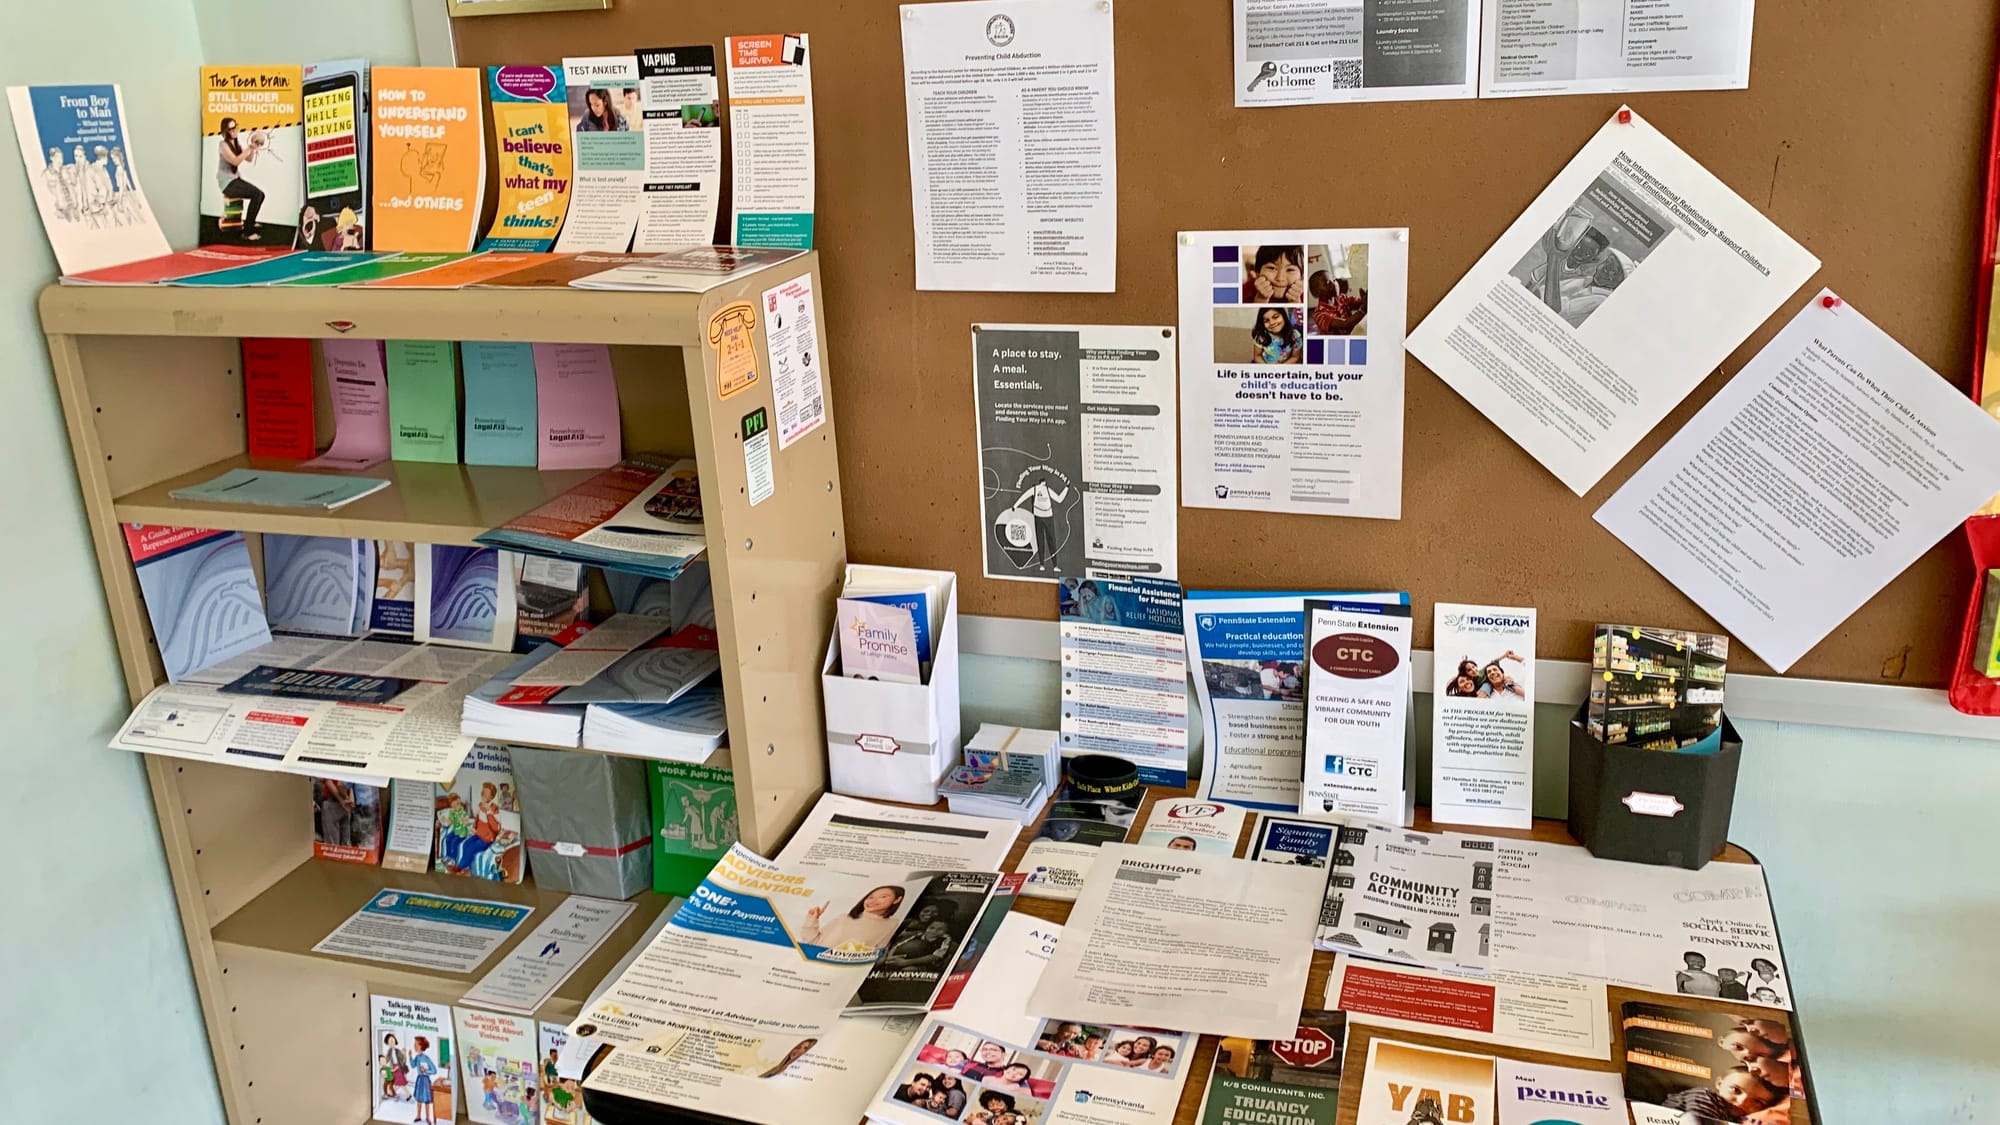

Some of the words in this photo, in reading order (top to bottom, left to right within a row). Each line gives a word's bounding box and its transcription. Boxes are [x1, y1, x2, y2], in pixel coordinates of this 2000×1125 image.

[738, 40, 772, 49] SCREEN
[642, 53, 676, 66] VAPING
[738, 56, 774, 65] SURVEY
[570, 66, 590, 76] TEST
[592, 65, 628, 74] ANXIETY
[1280, 63, 1332, 74] Connect
[209, 73, 228, 88] The
[230, 74, 257, 88] Teen
[1267, 78, 1278, 87] to
[1280, 76, 1316, 86] Home
[60, 95, 88, 108] From
[90, 94, 110, 108] Boy
[208, 92, 238, 102] STILL
[241, 92, 278, 103] UNDER
[306, 92, 350, 109] TEXTING
[378, 88, 406, 102] HOW
[410, 89, 426, 102] TO
[76, 108, 87, 118] to
[90, 107, 112, 118] Man
[208, 103, 294, 114] CONSTRUCTION
[306, 108, 338, 122] WHILE
[378, 106, 468, 122] UNDERSTAND
[307, 120, 352, 138] DRIVING
[378, 123, 446, 138] YOURSELF
[508, 127, 514, 137] I
[516, 123, 544, 137] can't
[502, 138, 562, 154] believe
[518, 156, 554, 176] that's
[505, 174, 550, 190] what
[553, 179, 568, 194] my
[414, 196, 464, 210] OTHERS
[518, 191, 554, 214] teen
[504, 214, 560, 228] thinks!
[1618, 150, 1632, 164] How
[1632, 160, 1681, 203] Intergenerational
[1680, 195, 1718, 234] Relationships
[1718, 230, 1742, 253] Support
[1741, 250, 1770, 278] Children's
[992, 349, 1000, 358] A
[1001, 349, 1028, 360] place
[1028, 350, 1038, 358] to
[1040, 350, 1062, 360] stay.
[993, 365, 1000, 374] A
[1002, 364, 1028, 374] meal.
[1217, 370, 1238, 378] Life
[1241, 370, 1250, 378] is
[1254, 370, 1312, 380] uncertain,
[1315, 371, 1334, 380] but
[1338, 373, 1363, 382] your
[994, 380, 1042, 390] Essentials.
[1241, 381, 1277, 389] child's
[1280, 381, 1338, 390] education
[1814, 338, 1828, 352] What
[1827, 348, 1846, 366] Parents
[1846, 364, 1857, 374] Can
[1857, 372, 1866, 381] Do
[1866, 378, 1881, 392] When
[1880, 391, 1895, 404] Their
[1895, 402, 1911, 416] Child
[1915, 419, 1937, 437] Anxious
[1235, 391, 1276, 400] doesn't
[1280, 392, 1307, 400] have
[1310, 392, 1322, 400] to
[1326, 392, 1343, 400] be.
[746, 411, 764, 436] PFI
[140, 535, 148, 544] A
[148, 527, 171, 540] Guide
[142, 529, 195, 551] Representative
[1108, 583, 1140, 594] Financial
[1141, 587, 1181, 600] Assistance
[1138, 594, 1150, 603] for
[1150, 596, 1181, 608] Families
[1126, 611, 1146, 620] RELIEF
[1148, 614, 1182, 626] HOTLINES
[1146, 606, 1180, 618] NATIONAL
[1218, 616, 1256, 624] PennState
[1257, 616, 1296, 624] Extension
[1318, 617, 1336, 626] Penn
[1338, 619, 1356, 628] State
[1358, 621, 1399, 632] Extension
[1470, 616, 1530, 628] PROGRAM
[858, 625, 898, 644] Family
[1226, 632, 1260, 640] Practical
[1262, 632, 1304, 640] education
[860, 638, 908, 656] Promise
[1336, 648, 1374, 662] CTC
[1316, 695, 1350, 704] CREATING
[1357, 698, 1374, 706] SAFE
[1315, 706, 1344, 714] VIBRANT
[1346, 708, 1391, 718] COMMUNITY
[1357, 720, 1380, 728] YOUTH
[1224, 746, 1266, 754] Educational
[1348, 766, 1372, 776] CTC
[1276, 826, 1326, 838] Signature
[1280, 835, 1318, 847] Family
[1276, 843, 1317, 854] Services
[732, 845, 768, 870] Experience
[768, 864, 780, 872] the
[724, 854, 807, 885] ADVISORS
[1121, 858, 1202, 875] BRIGHTHOPE
[715, 865, 814, 897] ADVANTAGE
[1369, 872, 1460, 898] COMMUNITY
[696, 886, 738, 906] ONE+
[1367, 882, 1424, 904] ACTION
[1426, 896, 1457, 904] LEHIGH
[1362, 894, 1390, 905] HOUSING
[1390, 899, 1428, 914] COUNSELING
[1429, 910, 1460, 918] PROGRAM
[1426, 900, 1457, 908] VALLEY
[568, 912, 600, 922] Danger
[550, 928, 587, 940] Bullying
[1552, 919, 1663, 939] www.compass.state.pa.us
[1682, 921, 1728, 933] SOCIAL
[1730, 927, 1772, 938] SERVIC
[388, 1000, 412, 1014] Talking
[414, 1002, 430, 1013] With
[381, 1008, 399, 1018] Your
[398, 1010, 414, 1020] Kids
[416, 1012, 437, 1023] About
[470, 1013, 496, 1026] Talking
[498, 1014, 516, 1026] With
[380, 1017, 404, 1027] School
[406, 1019, 440, 1032] Problems
[464, 1021, 478, 1029] Your
[481, 1023, 498, 1034] KIDS
[502, 1026, 524, 1036] About
[480, 1030, 510, 1042] Violence
[1280, 1038, 1327, 1055] STOP
[1242, 1082, 1306, 1098] CONSULTANTS,
[1308, 1092, 1326, 1100] INC.
[1517, 1086, 1609, 1106] pennie
[1093, 1095, 1145, 1110] pennsylvania
[1234, 1096, 1310, 1115] TRUANCY
[1388, 1082, 1475, 1124] YAB
[1224, 1107, 1316, 1125] EDUCATION
[1646, 1116, 1680, 1125] Ready
